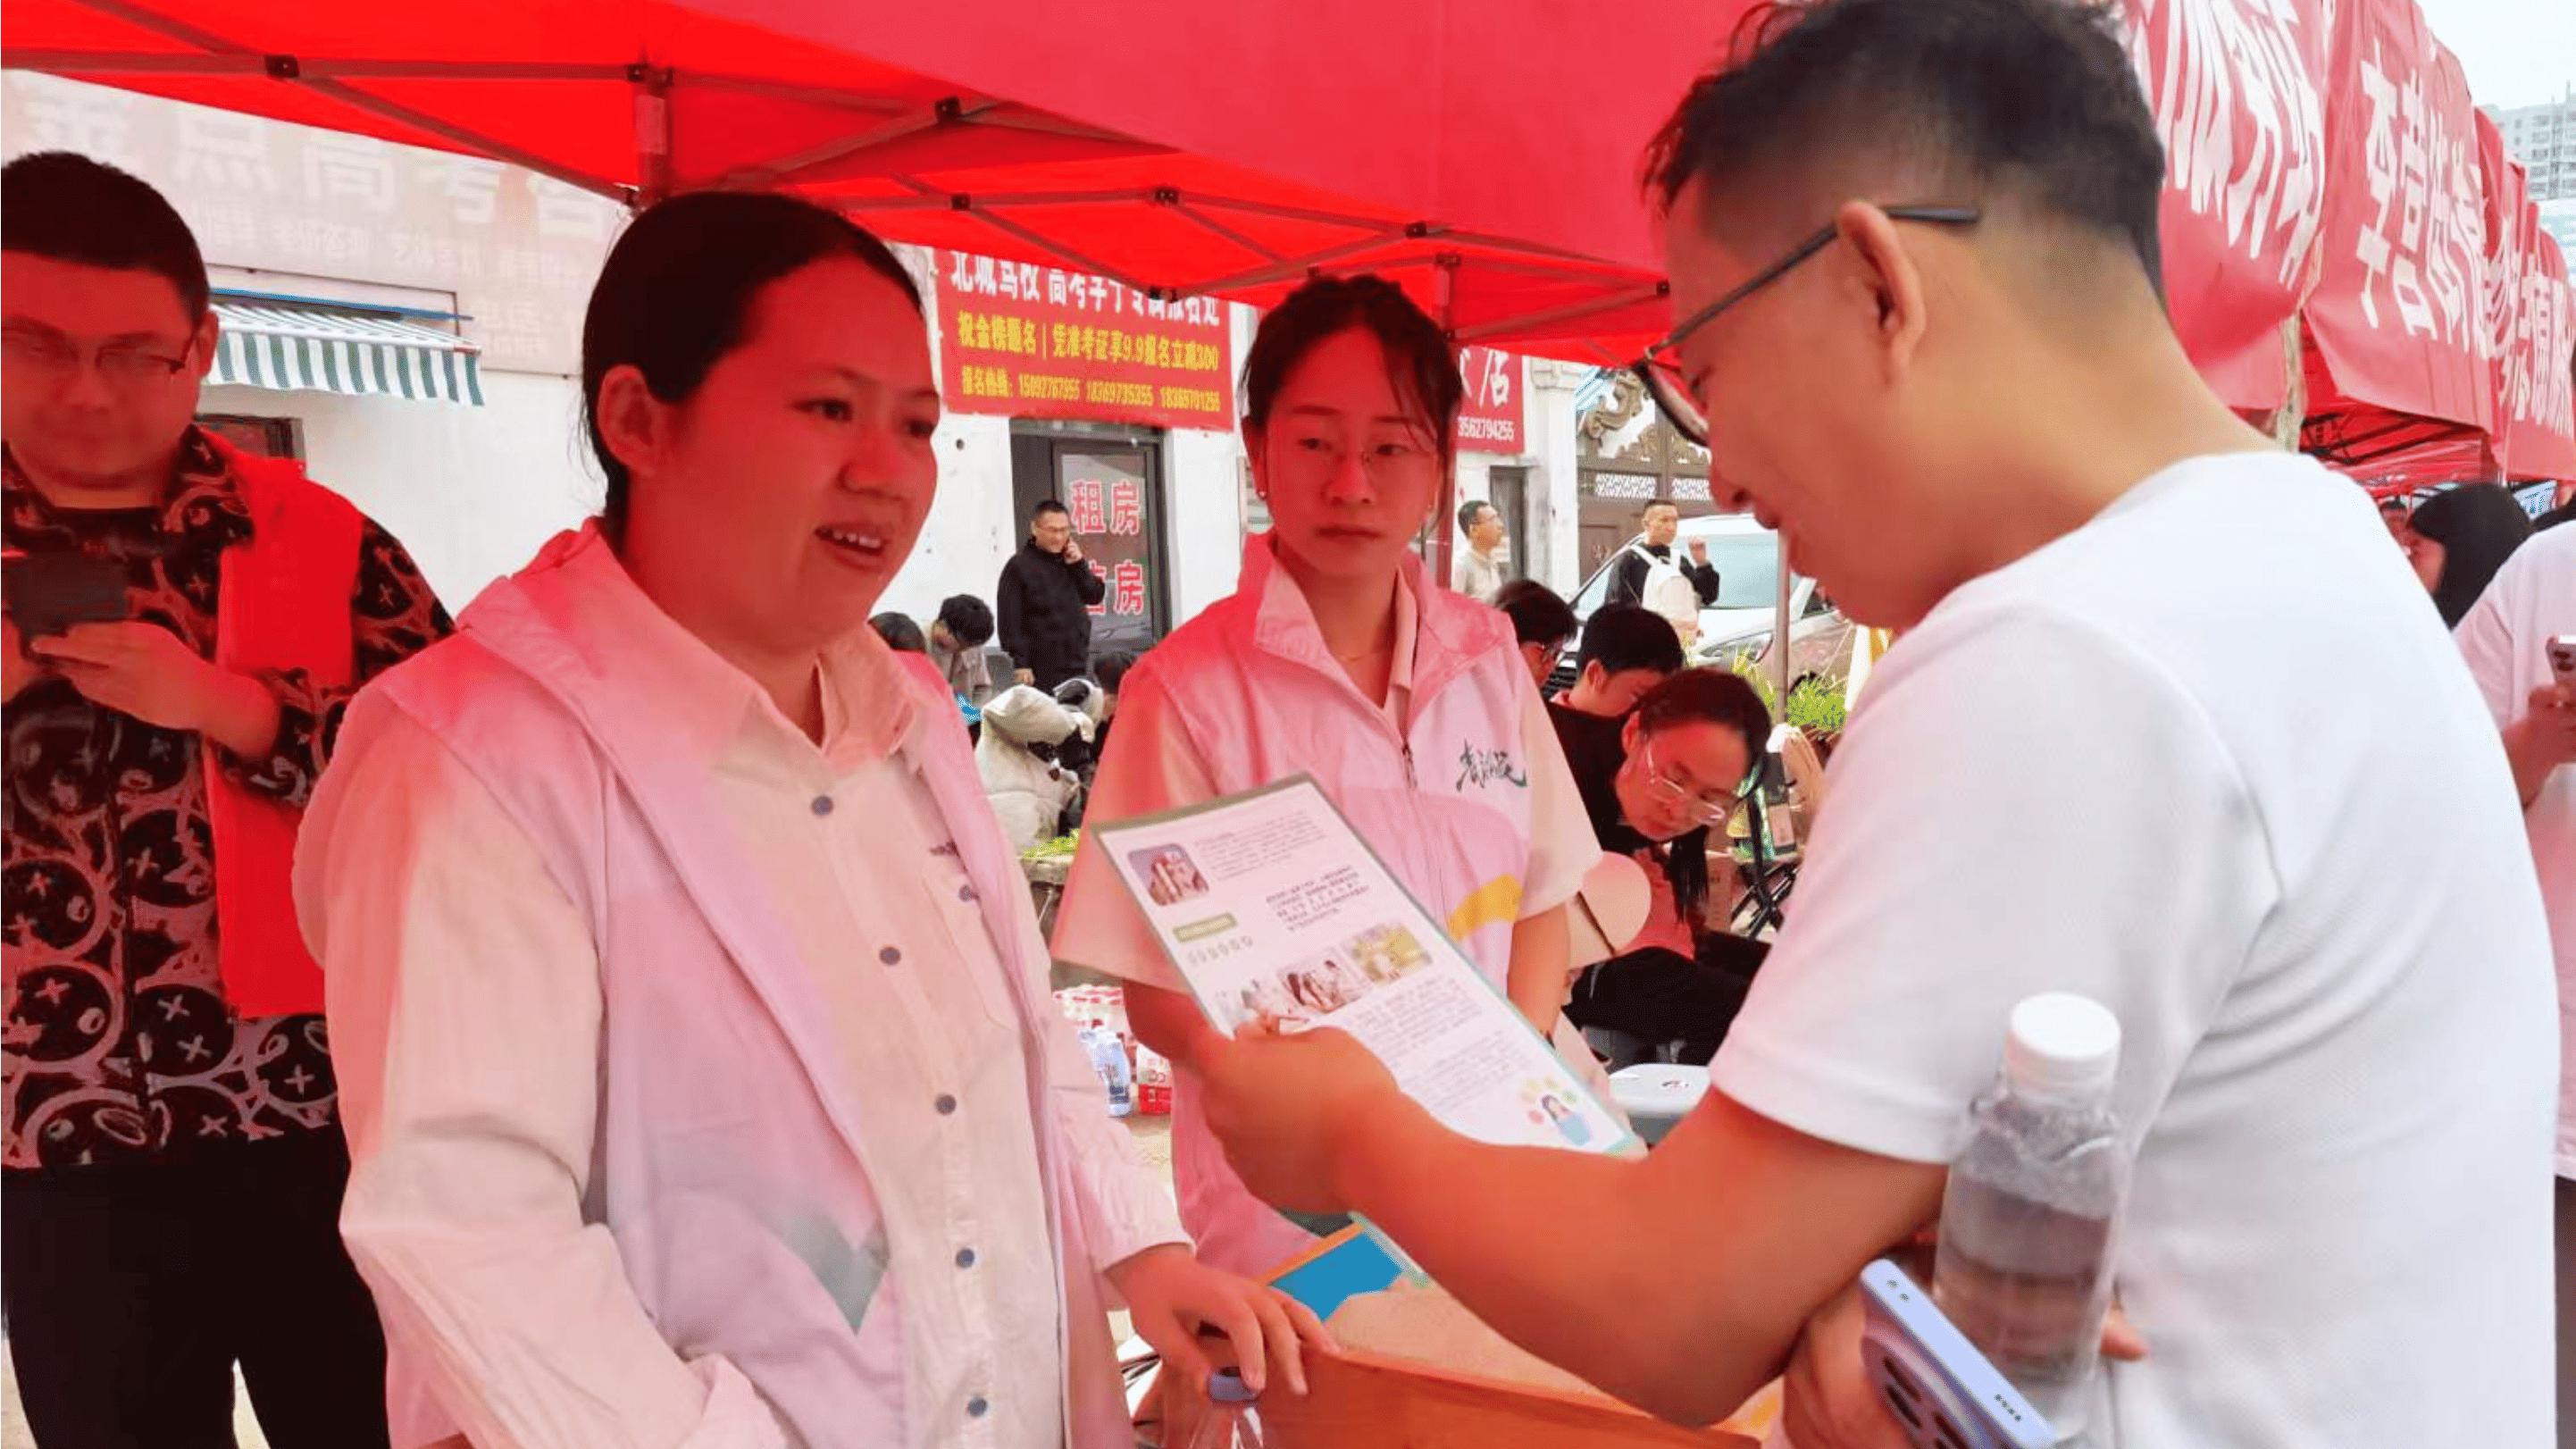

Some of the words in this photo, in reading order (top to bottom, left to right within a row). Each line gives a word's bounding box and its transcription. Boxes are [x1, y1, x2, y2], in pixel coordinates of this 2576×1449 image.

[1457, 416, 1516, 441] 3562794255
[1071, 479, 1142, 535] 租房
[1085, 559, 1144, 616] 房
